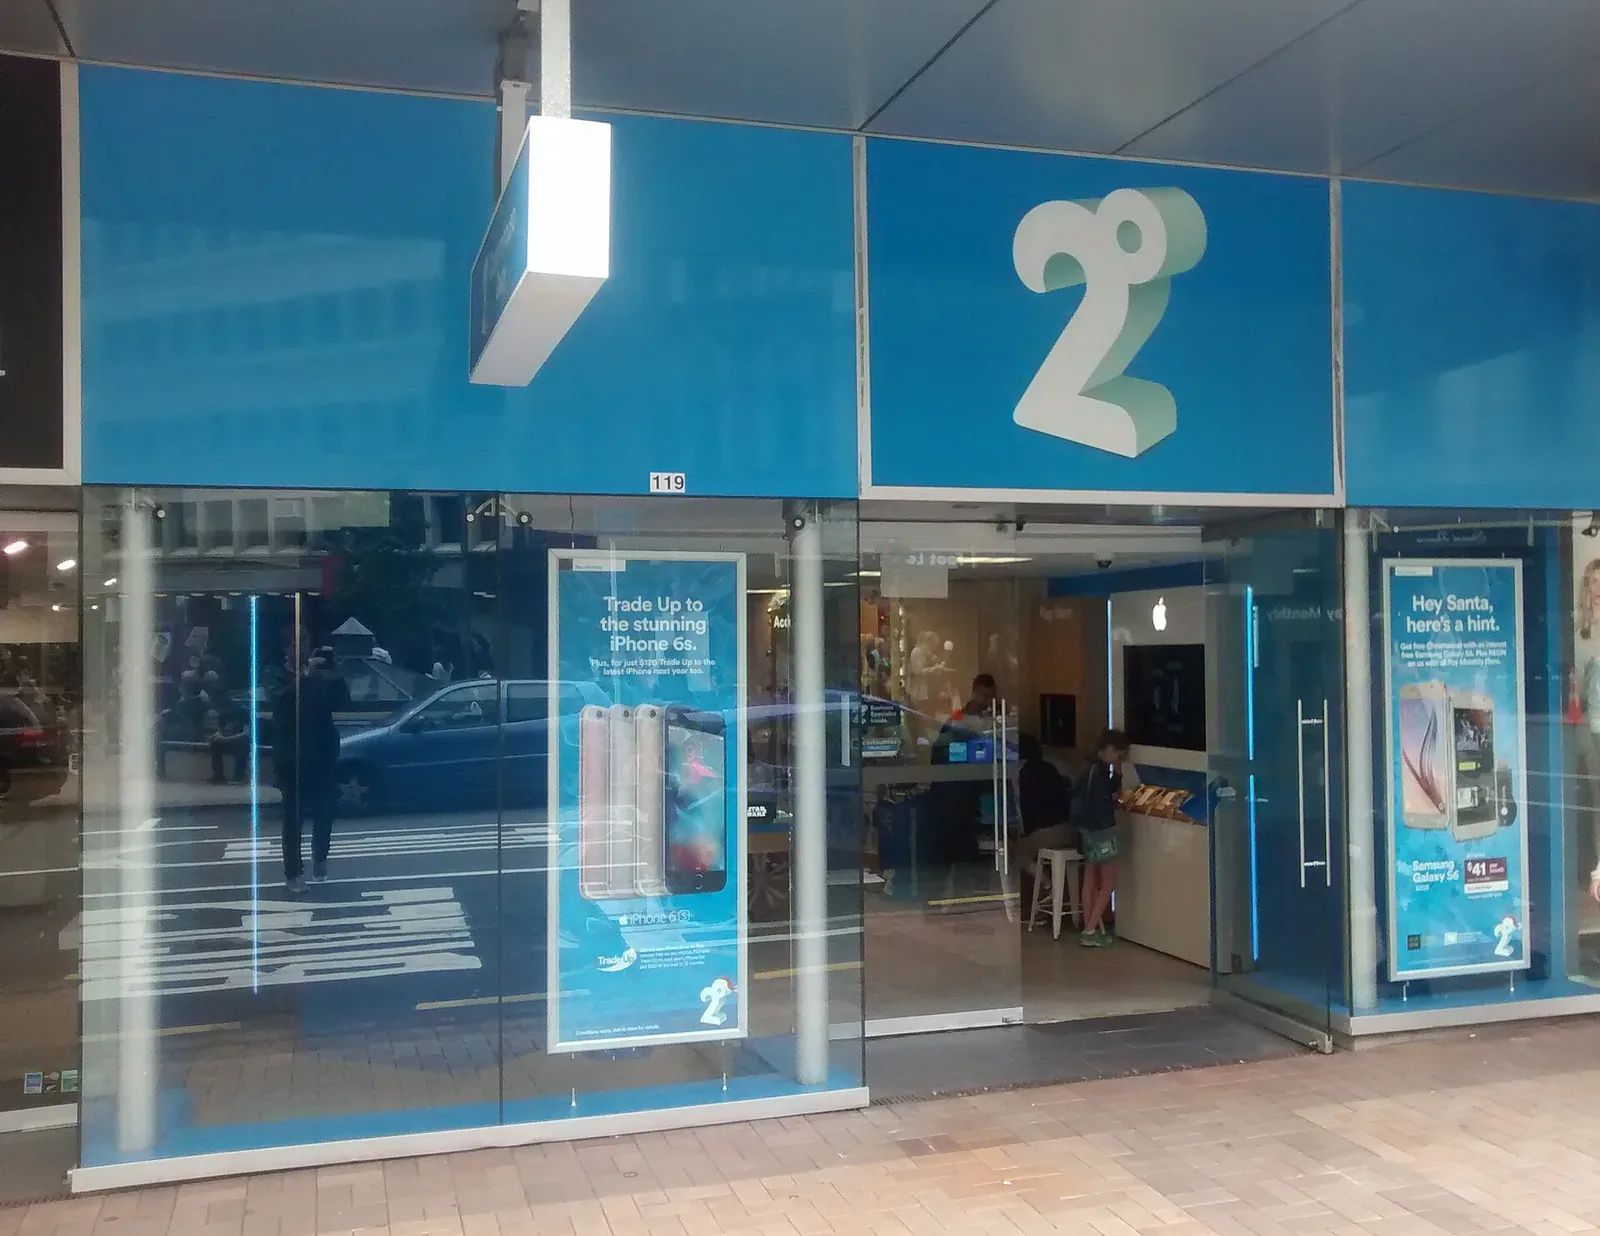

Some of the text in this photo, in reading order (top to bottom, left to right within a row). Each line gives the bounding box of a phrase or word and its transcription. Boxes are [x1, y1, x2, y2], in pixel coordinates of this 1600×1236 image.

[652, 475, 684, 490] 119
[603, 596, 703, 614] Trade Up to
[1412, 594, 1494, 615] Hey Santa,
[600, 616, 706, 635] the stunning
[1406, 615, 1500, 633] here's a hint.
[610, 636, 698, 652] iPhone 6s.
[623, 659, 638, 668] just
[660, 658, 681, 666] Trade
[682, 658, 693, 667] Up
[703, 658, 716, 666] the
[603, 668, 624, 676] latest
[626, 667, 652, 675] iPhone
[653, 667, 670, 675] next
[671, 668, 688, 676] year
[1413, 860, 1455, 872] Samsung
[1467, 861, 1486, 876] $41
[1413, 872, 1445, 883] Galaxy
[1446, 870, 1460, 881] S6
[630, 912, 667, 926] iPhone
